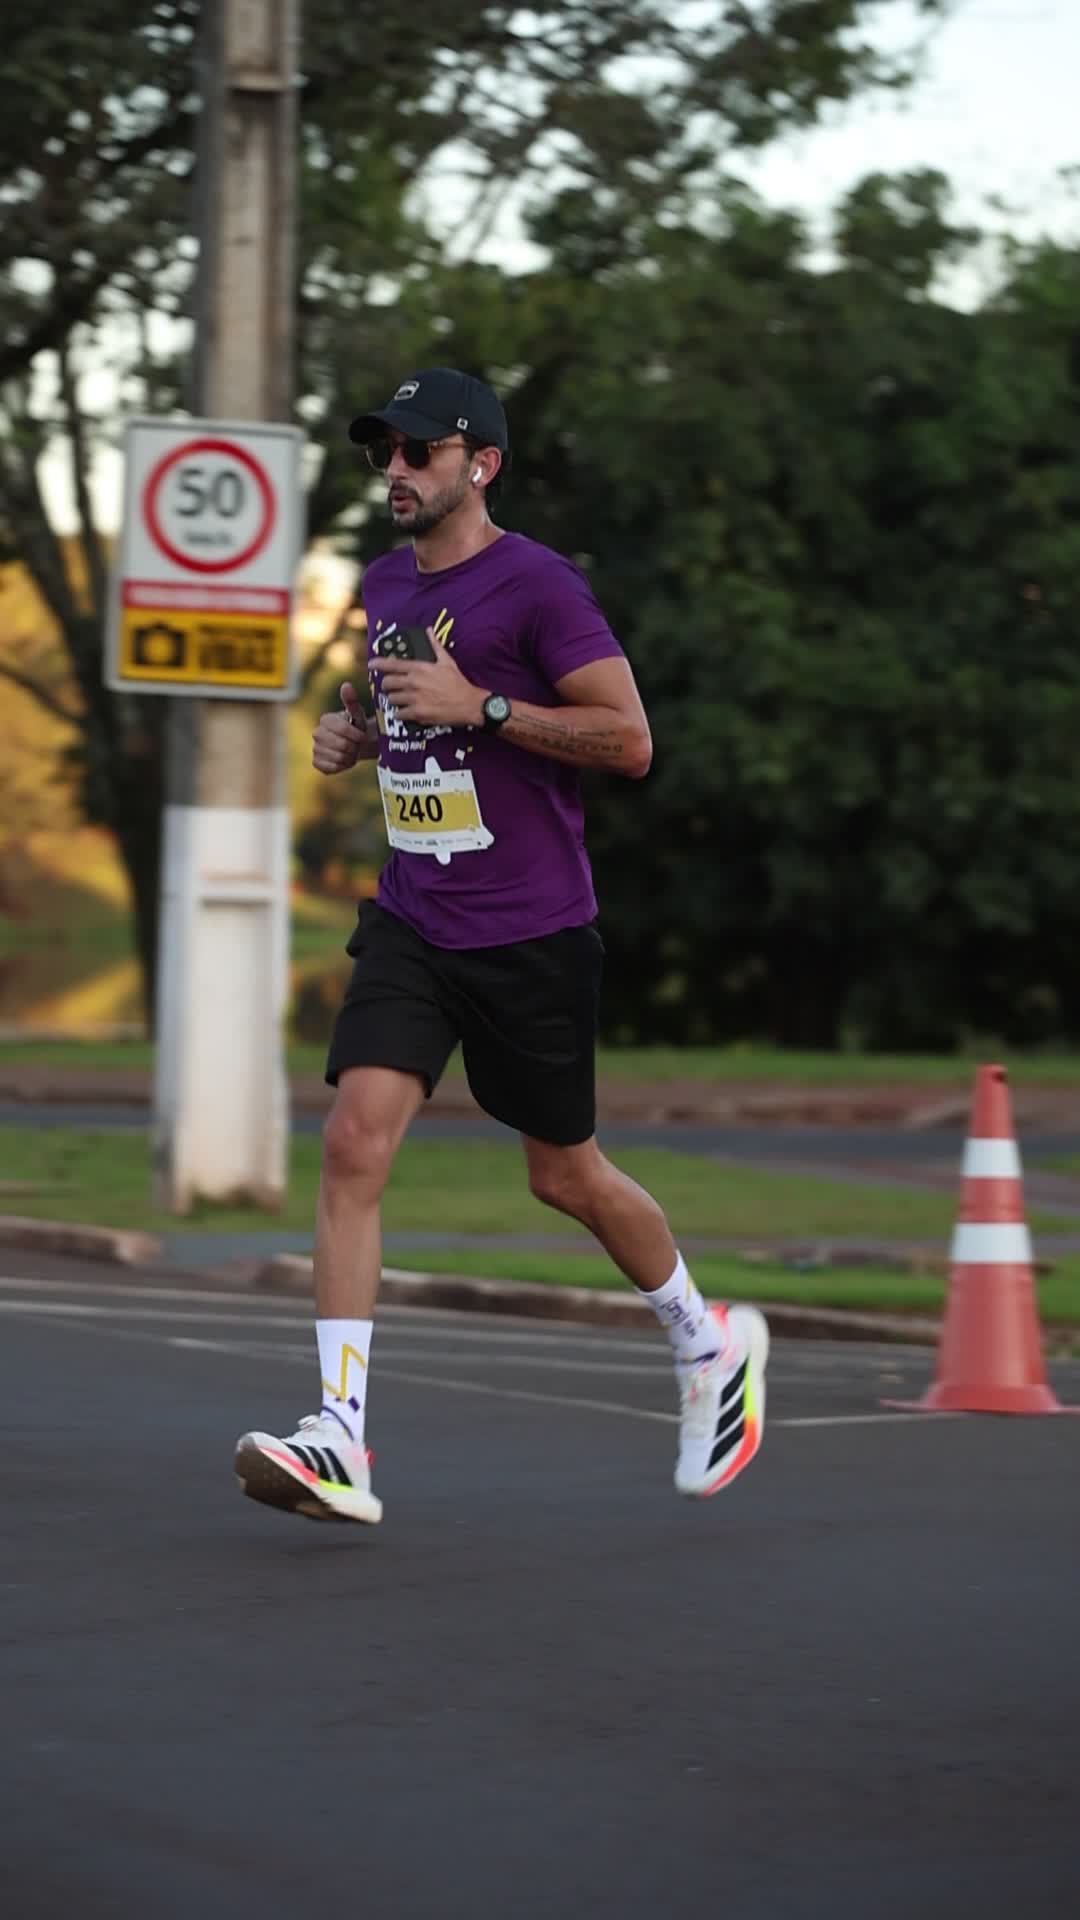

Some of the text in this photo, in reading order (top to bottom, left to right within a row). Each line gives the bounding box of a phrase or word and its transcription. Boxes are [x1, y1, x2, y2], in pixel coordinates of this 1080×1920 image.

[176, 467, 245, 518] 50
[412, 779, 431, 788] RUN
[396, 795, 443, 822] 240
